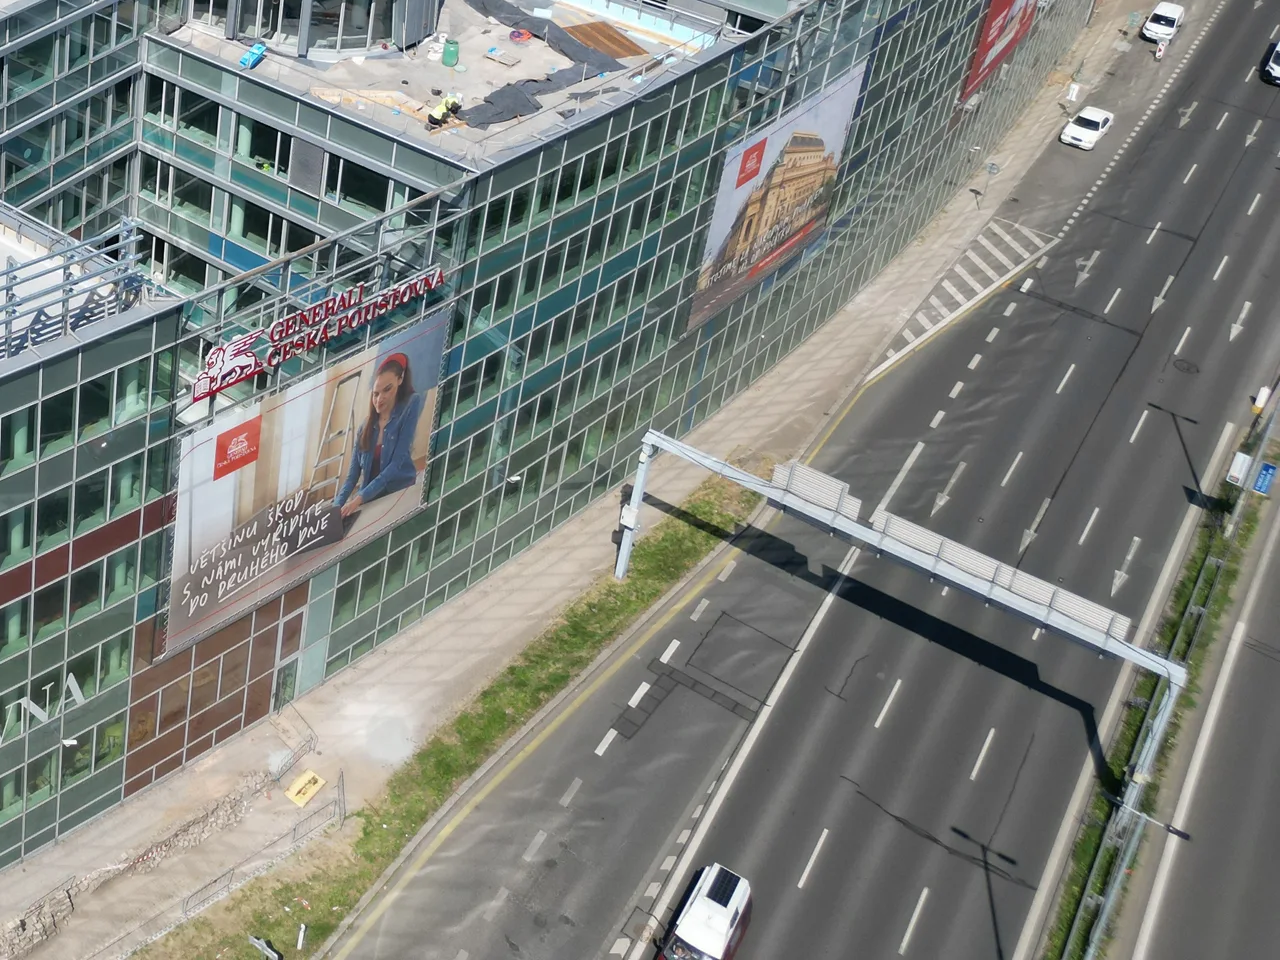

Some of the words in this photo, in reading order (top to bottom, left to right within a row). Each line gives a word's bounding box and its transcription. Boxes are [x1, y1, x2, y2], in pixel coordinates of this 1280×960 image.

[267, 318, 330, 368] ČESKÁ
[335, 268, 446, 336] POJIŠŤOVNA
[268, 282, 365, 344] GENERALI
[181, 582, 191, 606] S
[201, 553, 242, 589] NÁMI
[252, 498, 326, 556] VYŘÍDÍTE
[188, 592, 208, 617] DO
[217, 542, 289, 599] DRUHÉHO
[296, 513, 331, 549] DNE
[190, 521, 258, 575] VĚTŠINU
[267, 489, 304, 528] ŠKOD
